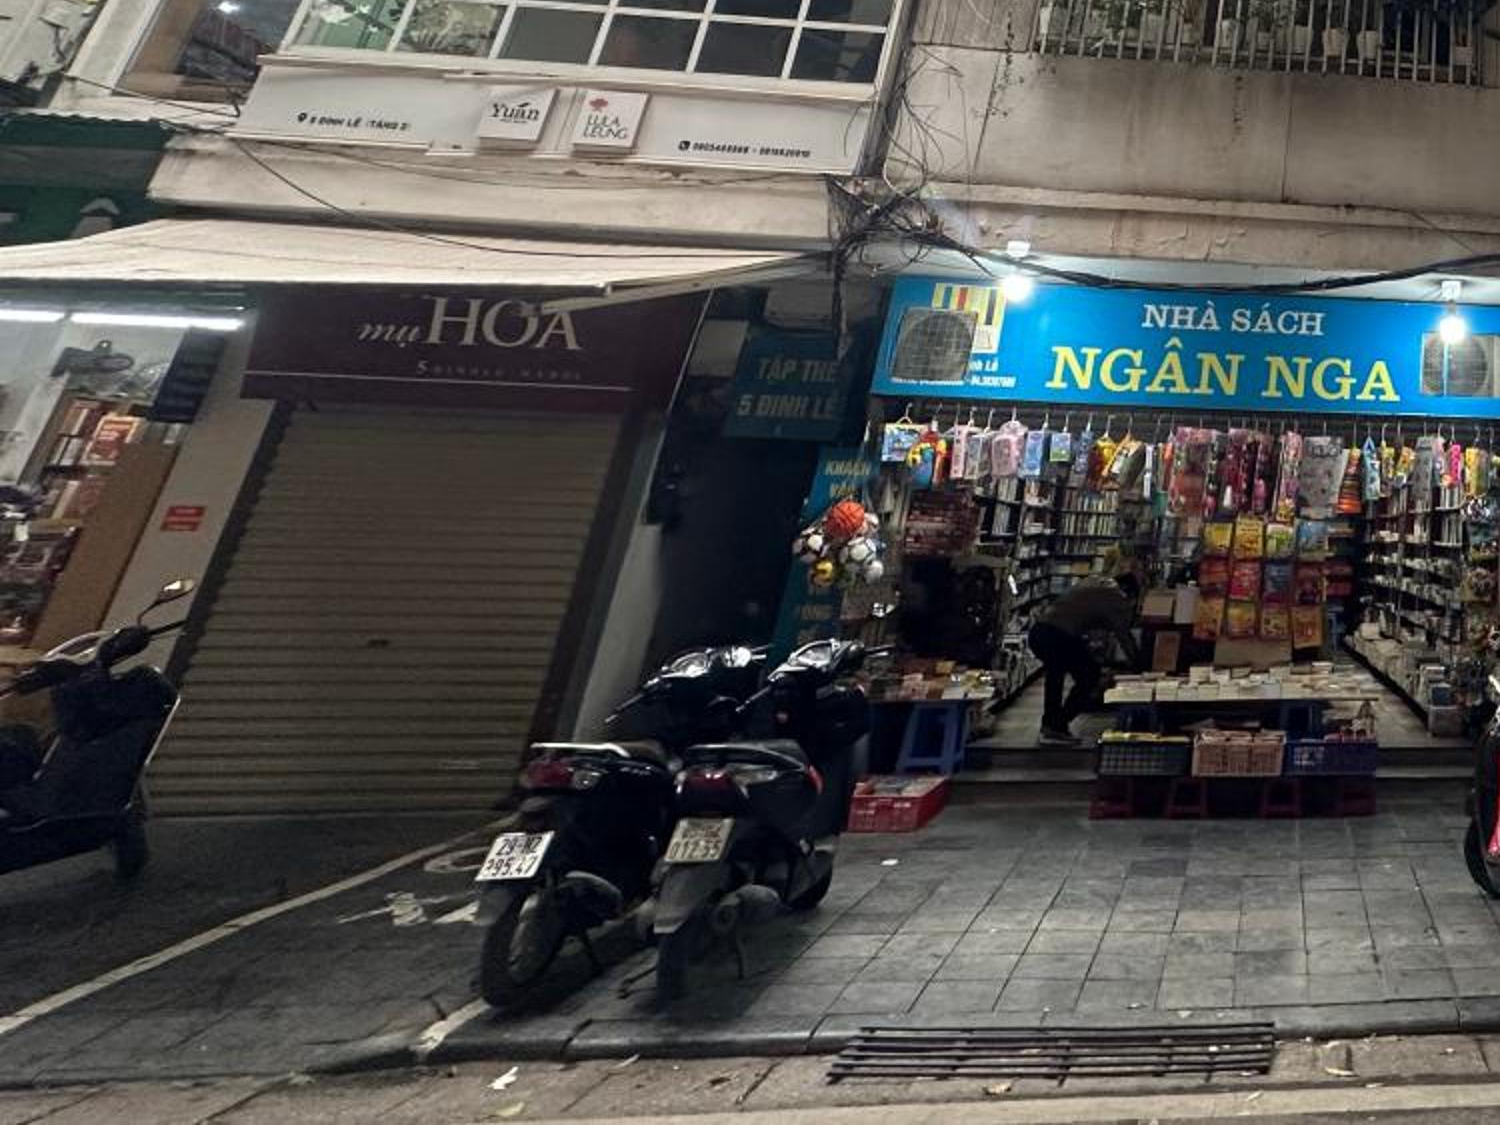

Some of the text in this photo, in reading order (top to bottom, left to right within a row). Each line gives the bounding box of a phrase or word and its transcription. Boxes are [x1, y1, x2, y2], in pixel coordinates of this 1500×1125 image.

[1142, 300, 1326, 336] NHÀ SÁCH
[1045, 337, 1401, 402] NGÂN NGA
[737, 394, 752, 416] 5
